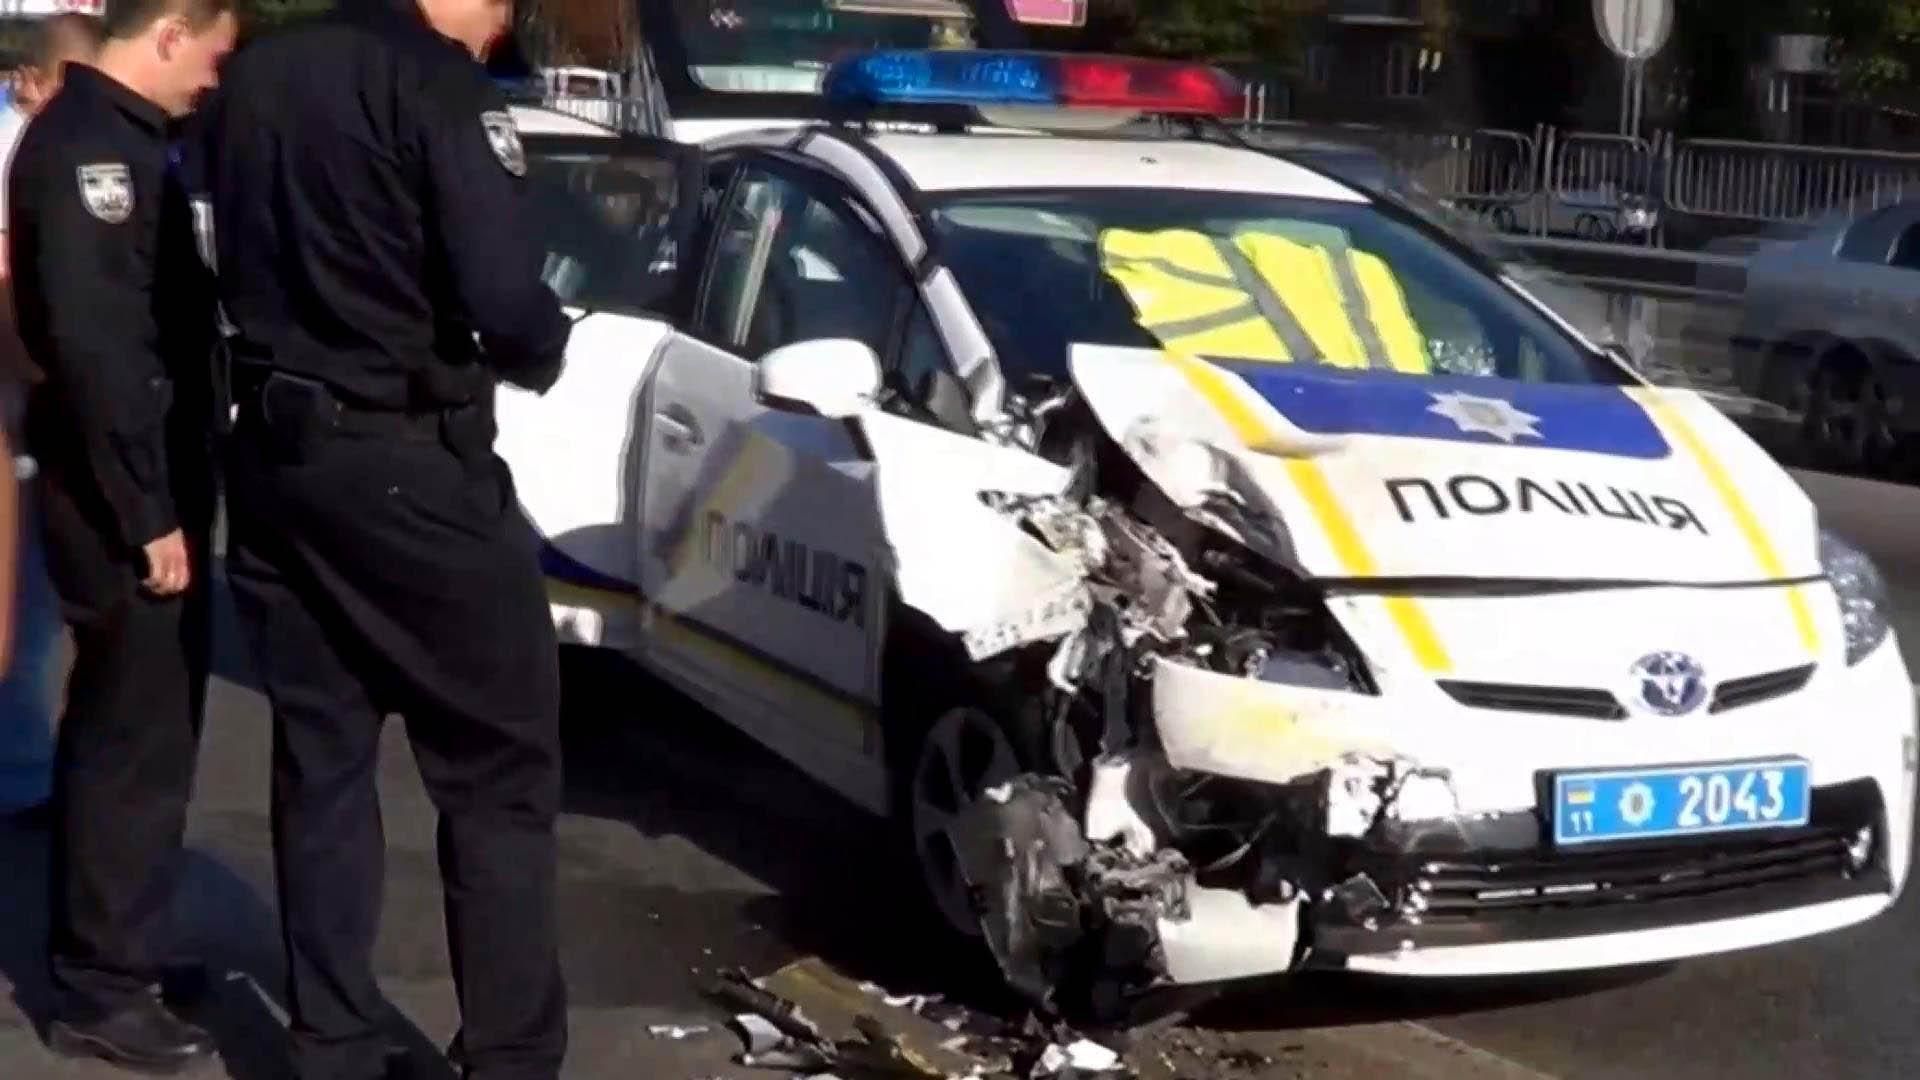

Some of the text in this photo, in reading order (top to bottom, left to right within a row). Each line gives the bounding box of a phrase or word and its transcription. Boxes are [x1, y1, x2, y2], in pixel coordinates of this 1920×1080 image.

[1384, 475, 1709, 535] ПОЛІЦІЯ
[706, 511, 867, 630] ПОЛІЦІЯ
[1569, 810, 1594, 834] 11
[1677, 769, 1785, 827] 2043
